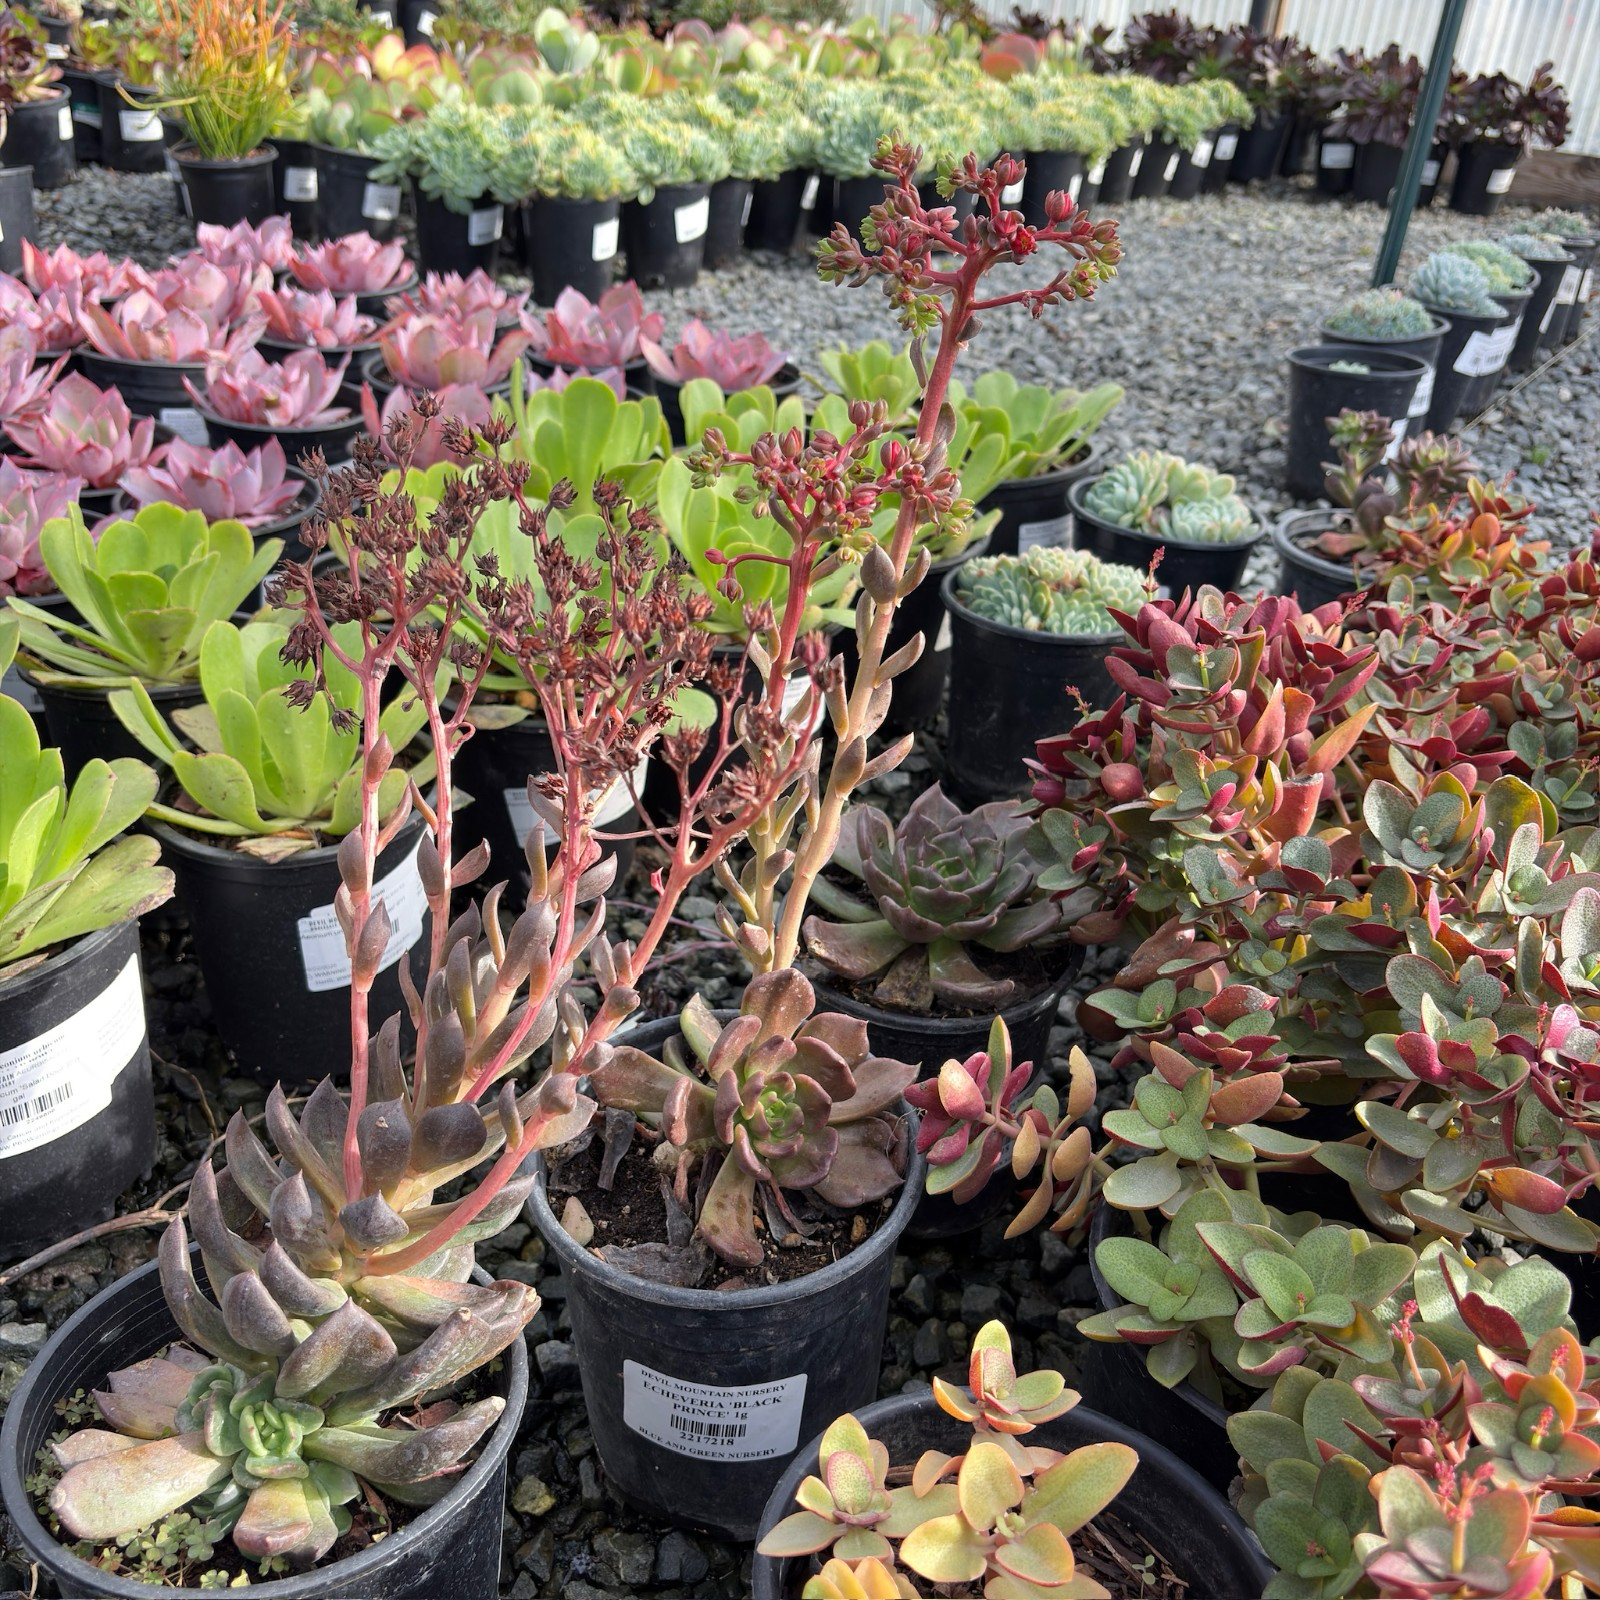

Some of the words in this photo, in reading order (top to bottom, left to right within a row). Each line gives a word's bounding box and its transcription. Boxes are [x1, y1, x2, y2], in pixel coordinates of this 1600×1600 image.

[641, 1369, 672, 1387] DEVIL
[674, 1383, 734, 1398] MOUNTAIN
[737, 1383, 788, 1398] NURSERY
[643, 1380, 725, 1409] ECHEVERIA
[729, 1395, 783, 1409] 'BLACK
[673, 1402, 730, 1418] PRINCE'
[639, 1426, 664, 1443] BLUE
[665, 1439, 687, 1452] AND
[689, 1447, 725, 1459] GREEN
[727, 1447, 777, 1460] NURSERY
[679, 1431, 735, 1446] 2217218
